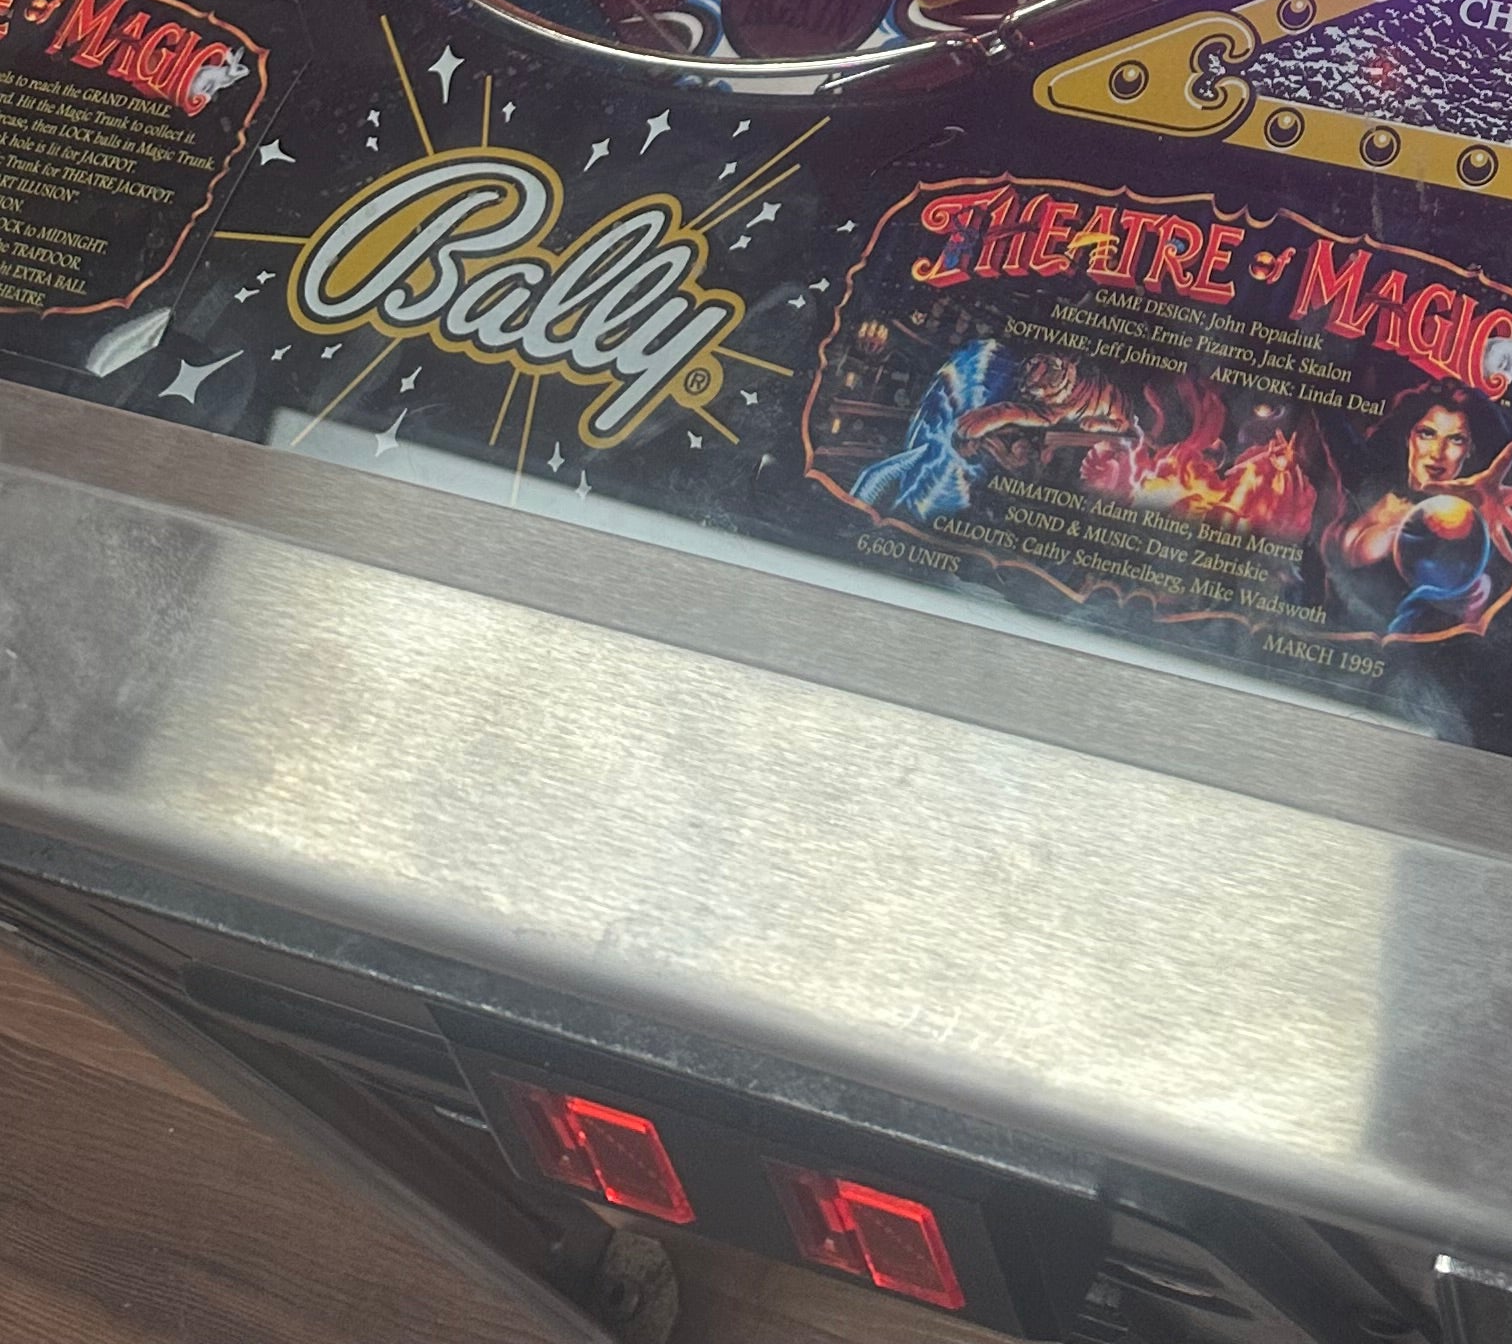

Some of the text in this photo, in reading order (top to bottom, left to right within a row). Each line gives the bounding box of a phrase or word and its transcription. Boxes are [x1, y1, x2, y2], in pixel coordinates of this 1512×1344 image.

[15, 73, 28, 88] to
[28, 78, 60, 96] reach
[62, 82, 81, 99] the
[82, 87, 128, 108] GRAND
[17, 93, 36, 110] Hit
[36, 97, 56, 114] the
[56, 102, 93, 124] Magic
[95, 110, 130, 131] Trunk
[130, 118, 143, 134] to
[144, 120, 183, 143] collect
[182, 129, 196, 145] it.
[31, 116, 58, 137] then
[58, 123, 96, 144] LOCK
[94, 130, 121, 149] balls
[122, 137, 136, 153] in
[135, 140, 177, 164] Magic
[6, 153, 176, 206] Trunk for THEATRE JACKPOT.
[9, 134, 36, 153] hole
[36, 138, 47, 155] is
[49, 140, 62, 158] lit
[60, 143, 81, 162] for
[79, 149, 137, 175] JACKPOT.
[24, 221, 37, 237] to
[36, 226, 109, 255] MIDNIGHT.
[911, 187, 1246, 304] THEATRE
[1248, 247, 1297, 285] of
[12, 264, 54, 285] EXTRA
[296, 154, 738, 440] Bally
[1004, 318, 1189, 375] SOFTWARE: Jeff Johnson
[1050, 303, 1354, 383] MECHANICS: Ernie Pizarro, Jack Skalon
[1095, 289, 1325, 352] GAME DESIGN: John Popadiuk
[1210, 365, 1388, 417] ARTWORK: Linda Deal
[986, 474, 1304, 563] ANIMATION: Adam Rhine, Brian Morris
[1004, 505, 1269, 583] SOUND & MUSIC: Dave Zabriskie
[856, 534, 961, 573] 6,600 UNITS
[932, 513, 1328, 626] CALLOUTS: Cathy Schenkelberg, Mike Wadswoth
[1261, 632, 1386, 679] MARCH 1995
